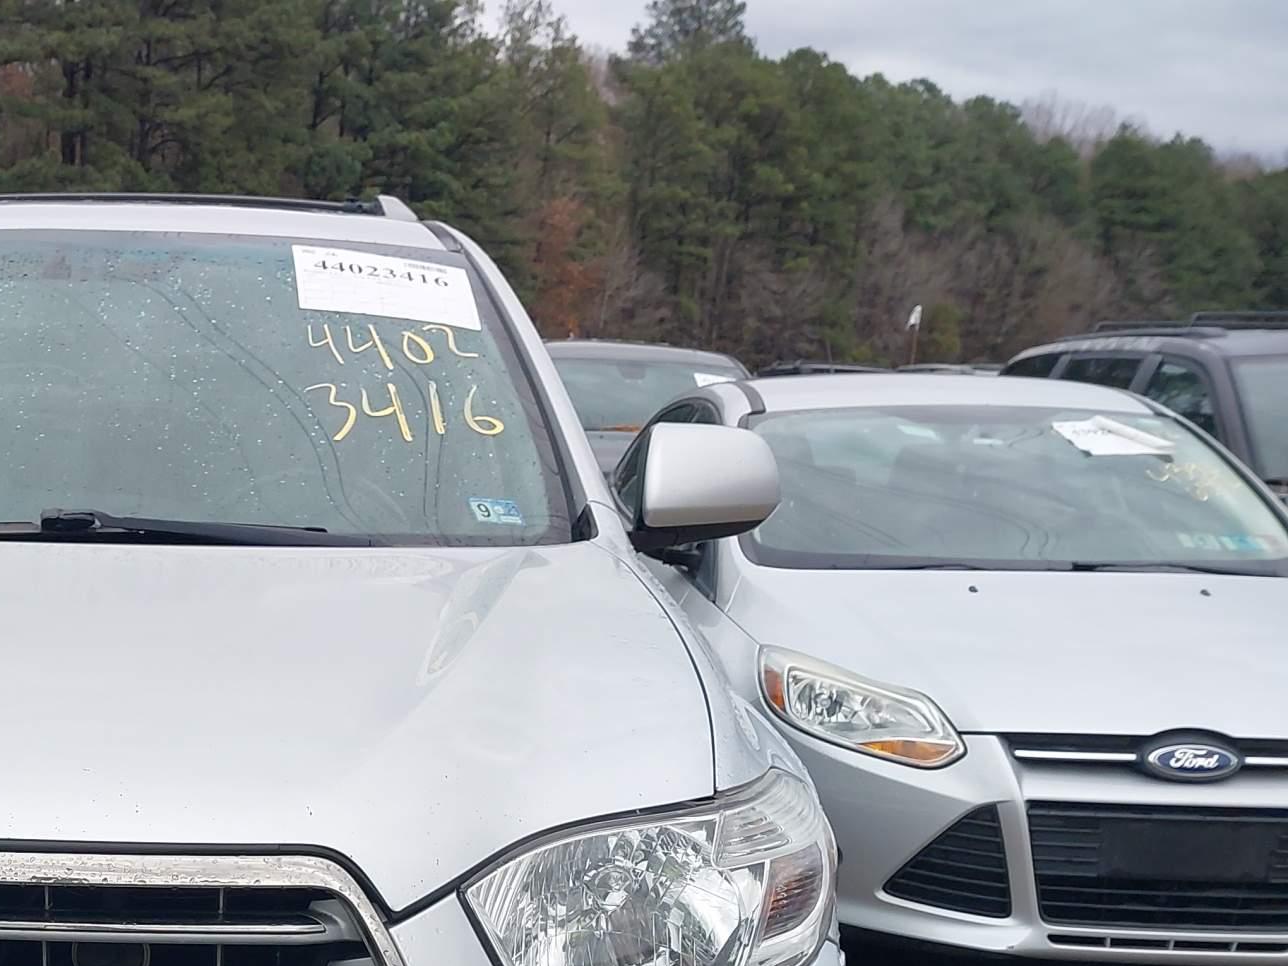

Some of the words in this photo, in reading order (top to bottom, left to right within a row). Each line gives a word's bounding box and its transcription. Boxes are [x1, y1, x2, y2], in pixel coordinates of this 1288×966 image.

[313, 259, 449, 288] 44023416
[306, 323, 480, 370] 4402
[303, 382, 505, 442] 3416
[476, 503, 491, 518] 9
[1169, 748, 1220, 769] Ford
